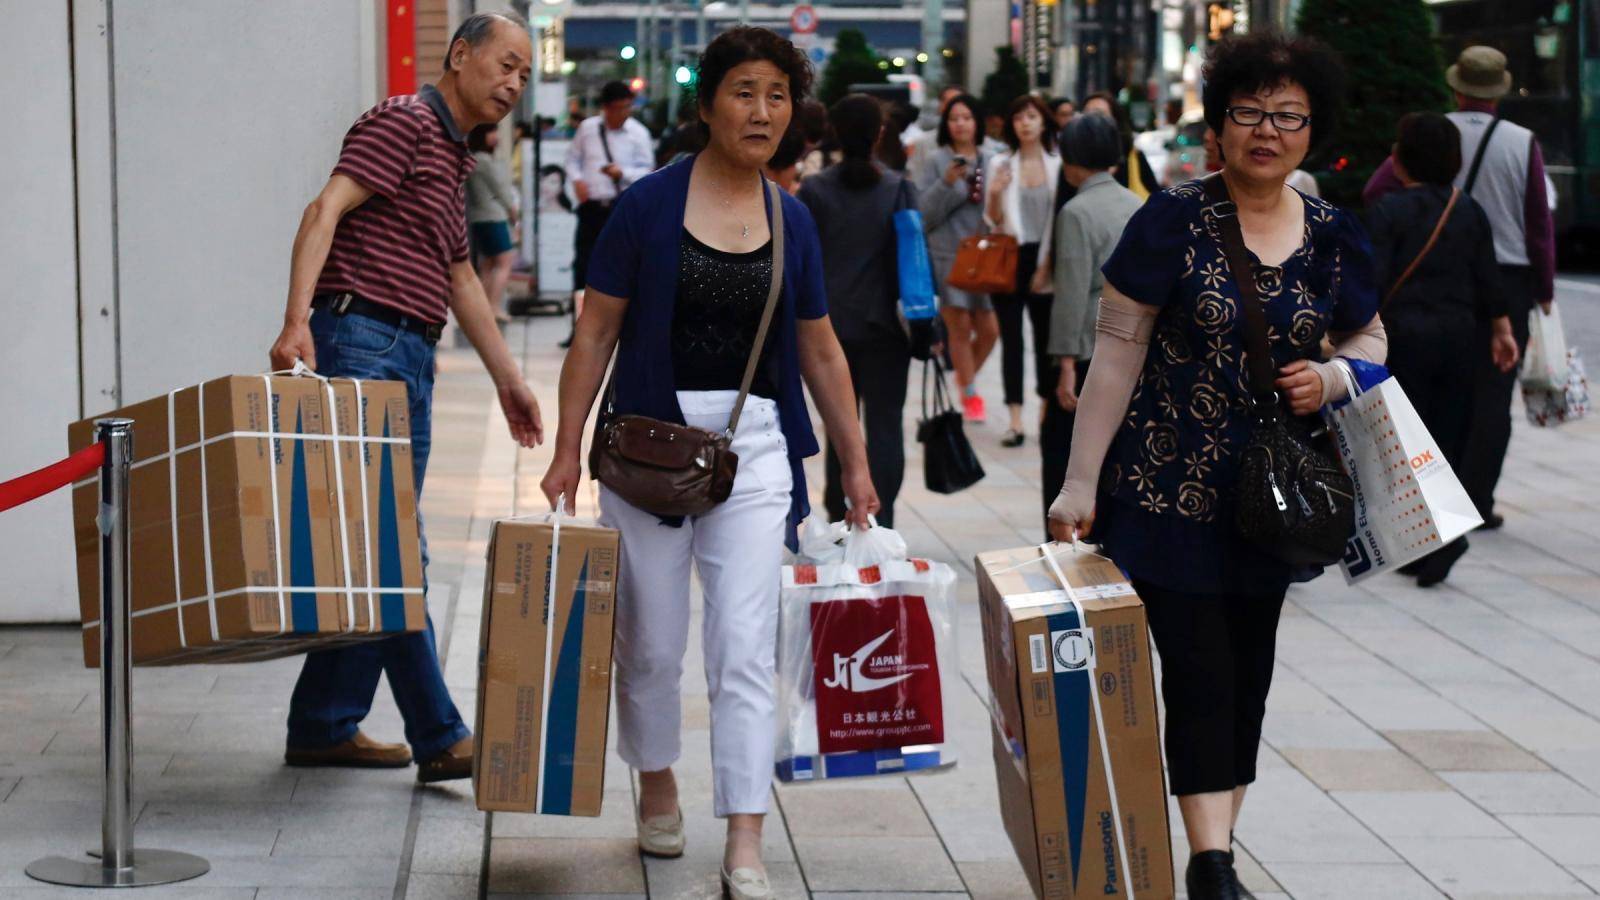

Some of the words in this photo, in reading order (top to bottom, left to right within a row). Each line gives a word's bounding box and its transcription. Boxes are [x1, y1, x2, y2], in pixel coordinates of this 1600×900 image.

[1335, 421, 1351, 457] Store
[1349, 458, 1368, 526] Electronics
[1365, 530, 1385, 566] Home
[869, 655, 903, 667] JAPAN
[842, 709, 916, 724] 日本観光公社
[1097, 811, 1117, 895] Panasonic
